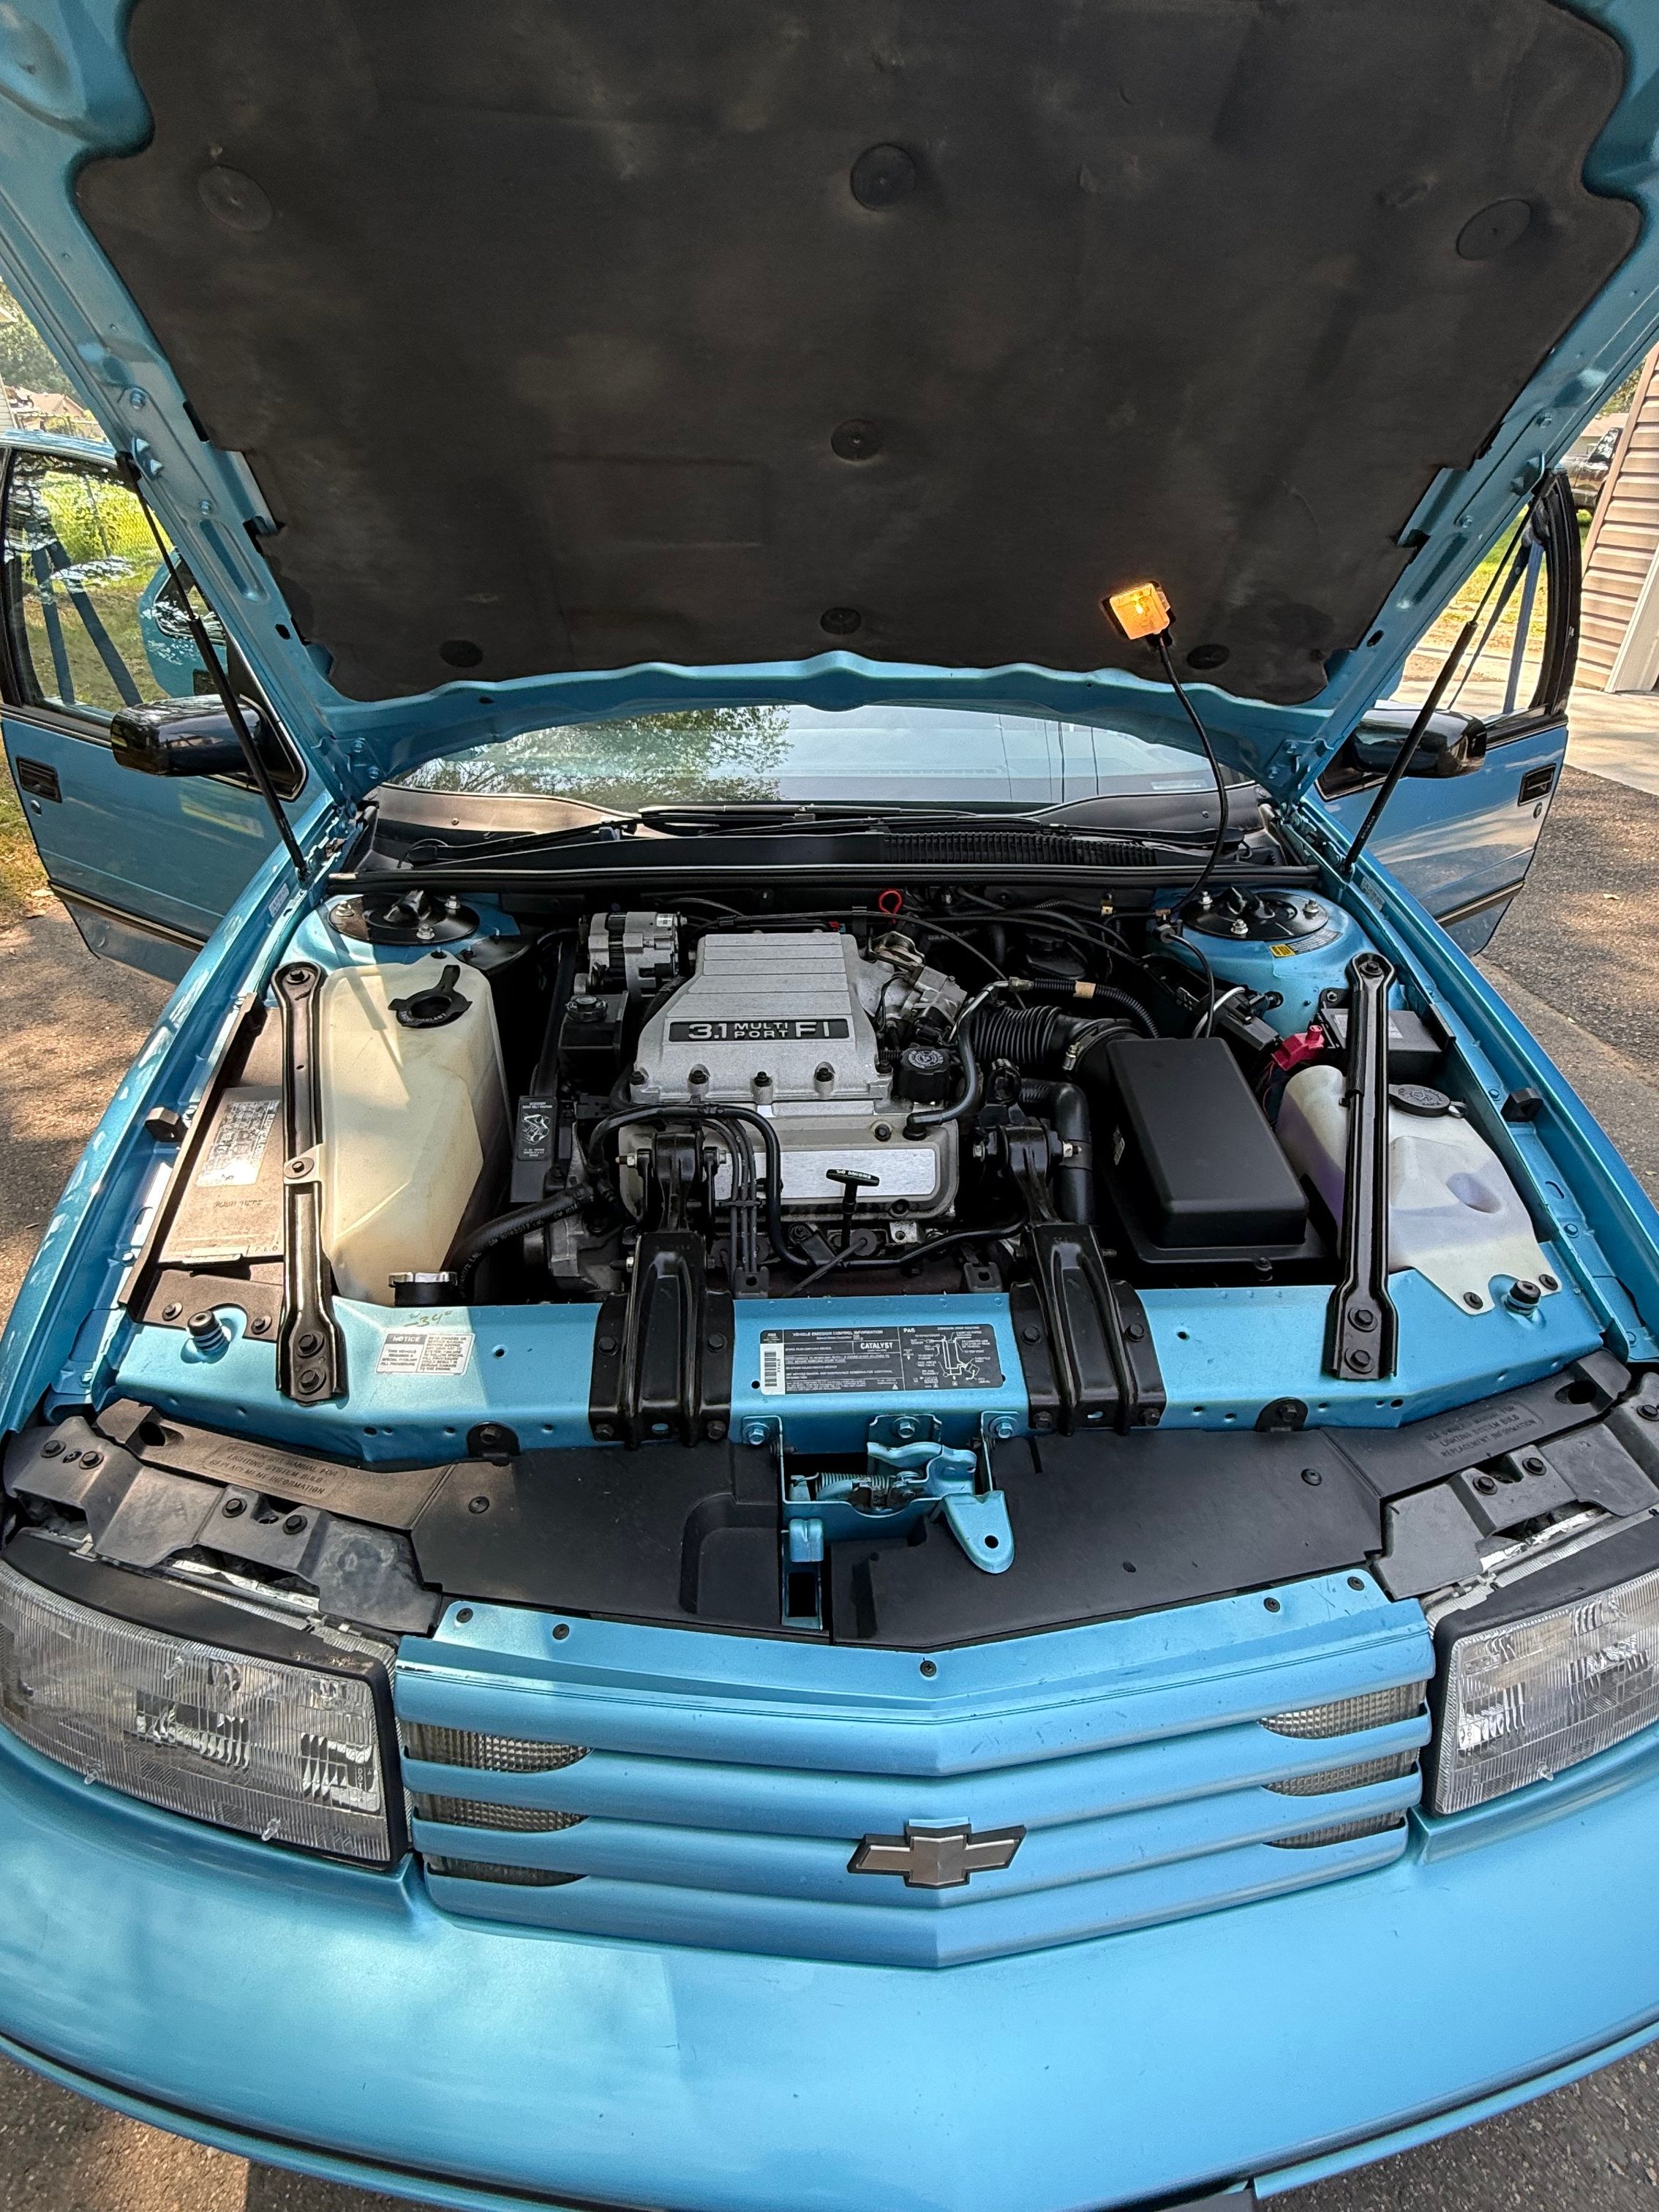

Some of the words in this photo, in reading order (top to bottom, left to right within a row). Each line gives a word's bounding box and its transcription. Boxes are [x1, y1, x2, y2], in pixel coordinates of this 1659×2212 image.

[688, 1023, 727, 1039] 3.1
[795, 1022, 830, 1037] FI
[734, 1030, 788, 1039] PORT
[269, 1475, 326, 1495] INFORMATION
